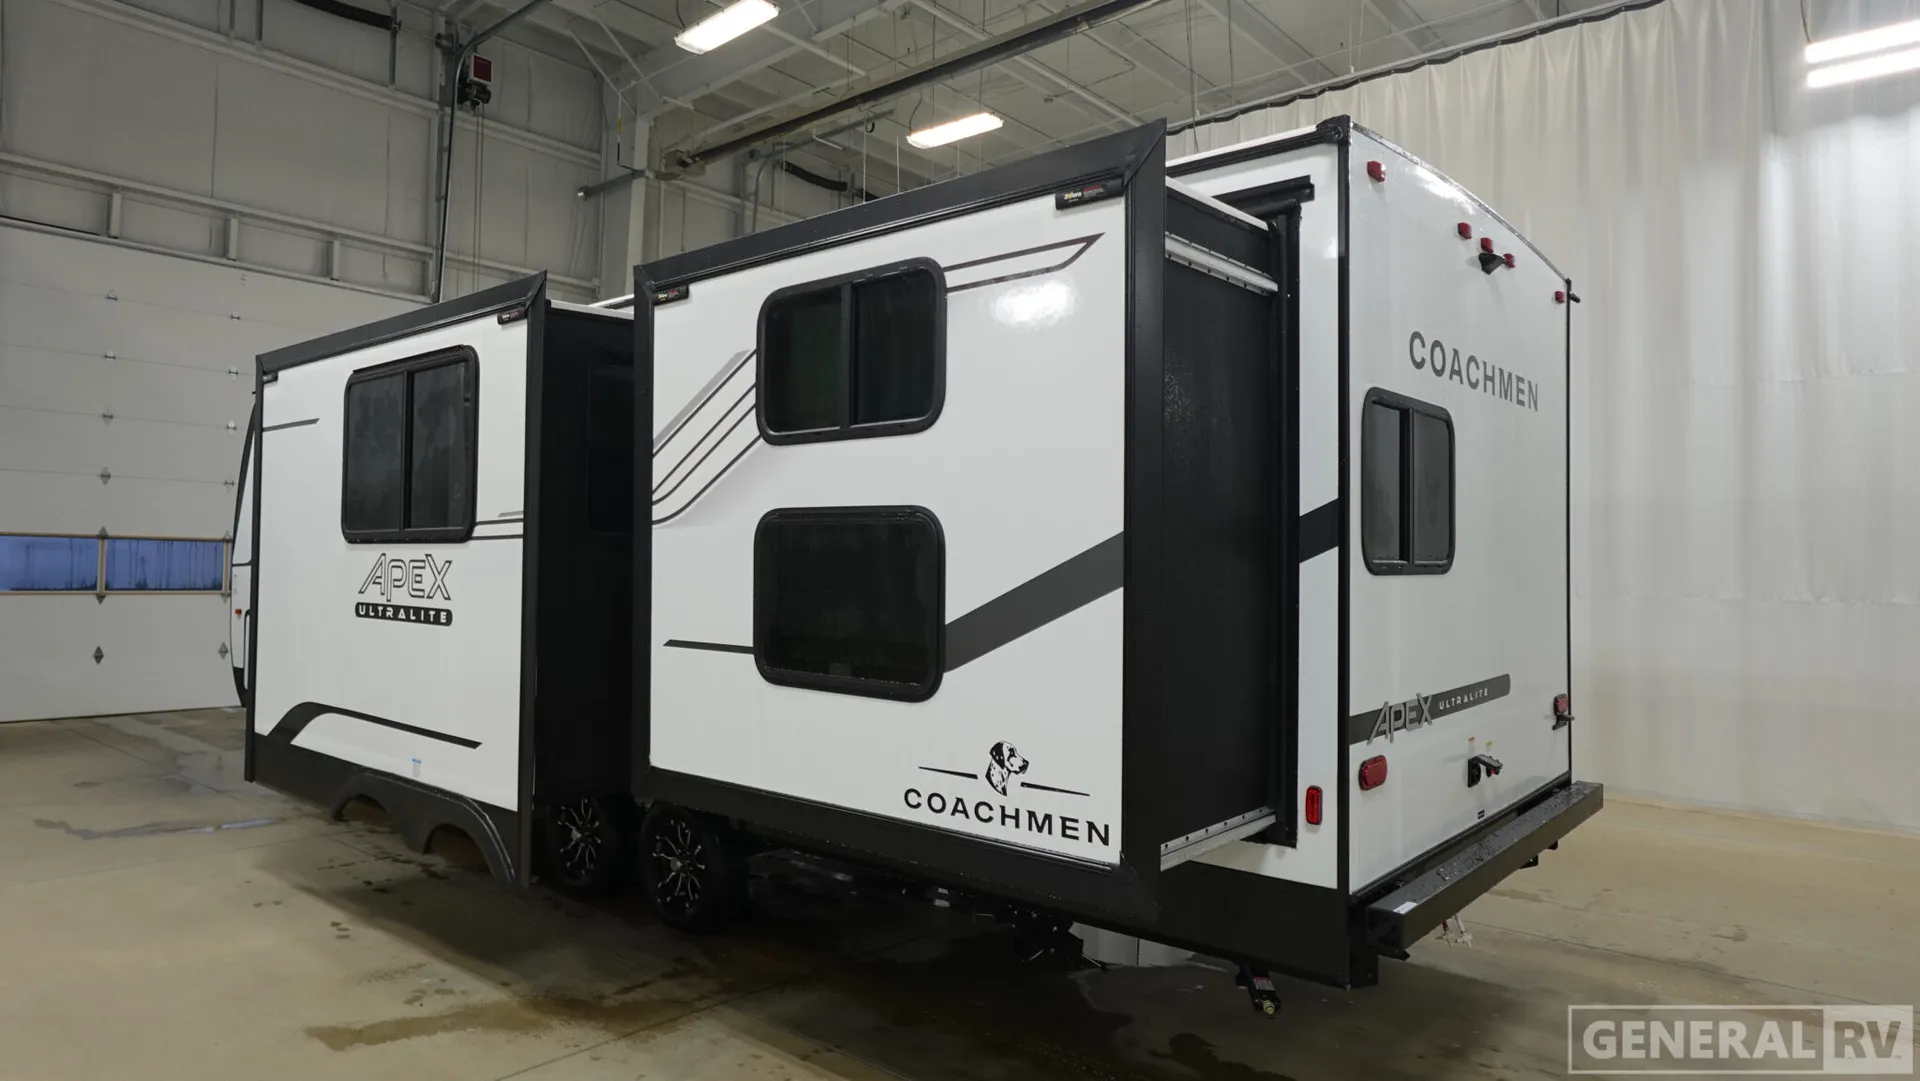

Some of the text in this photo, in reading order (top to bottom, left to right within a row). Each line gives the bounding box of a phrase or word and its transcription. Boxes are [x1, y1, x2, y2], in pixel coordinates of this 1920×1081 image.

[1409, 331, 1538, 412] COACHMEN
[358, 553, 453, 602] APEX
[359, 604, 447, 623] ULTRALITE
[1366, 687, 1489, 745] APEX ULTRALITE
[904, 788, 1110, 846] COACHMEN
